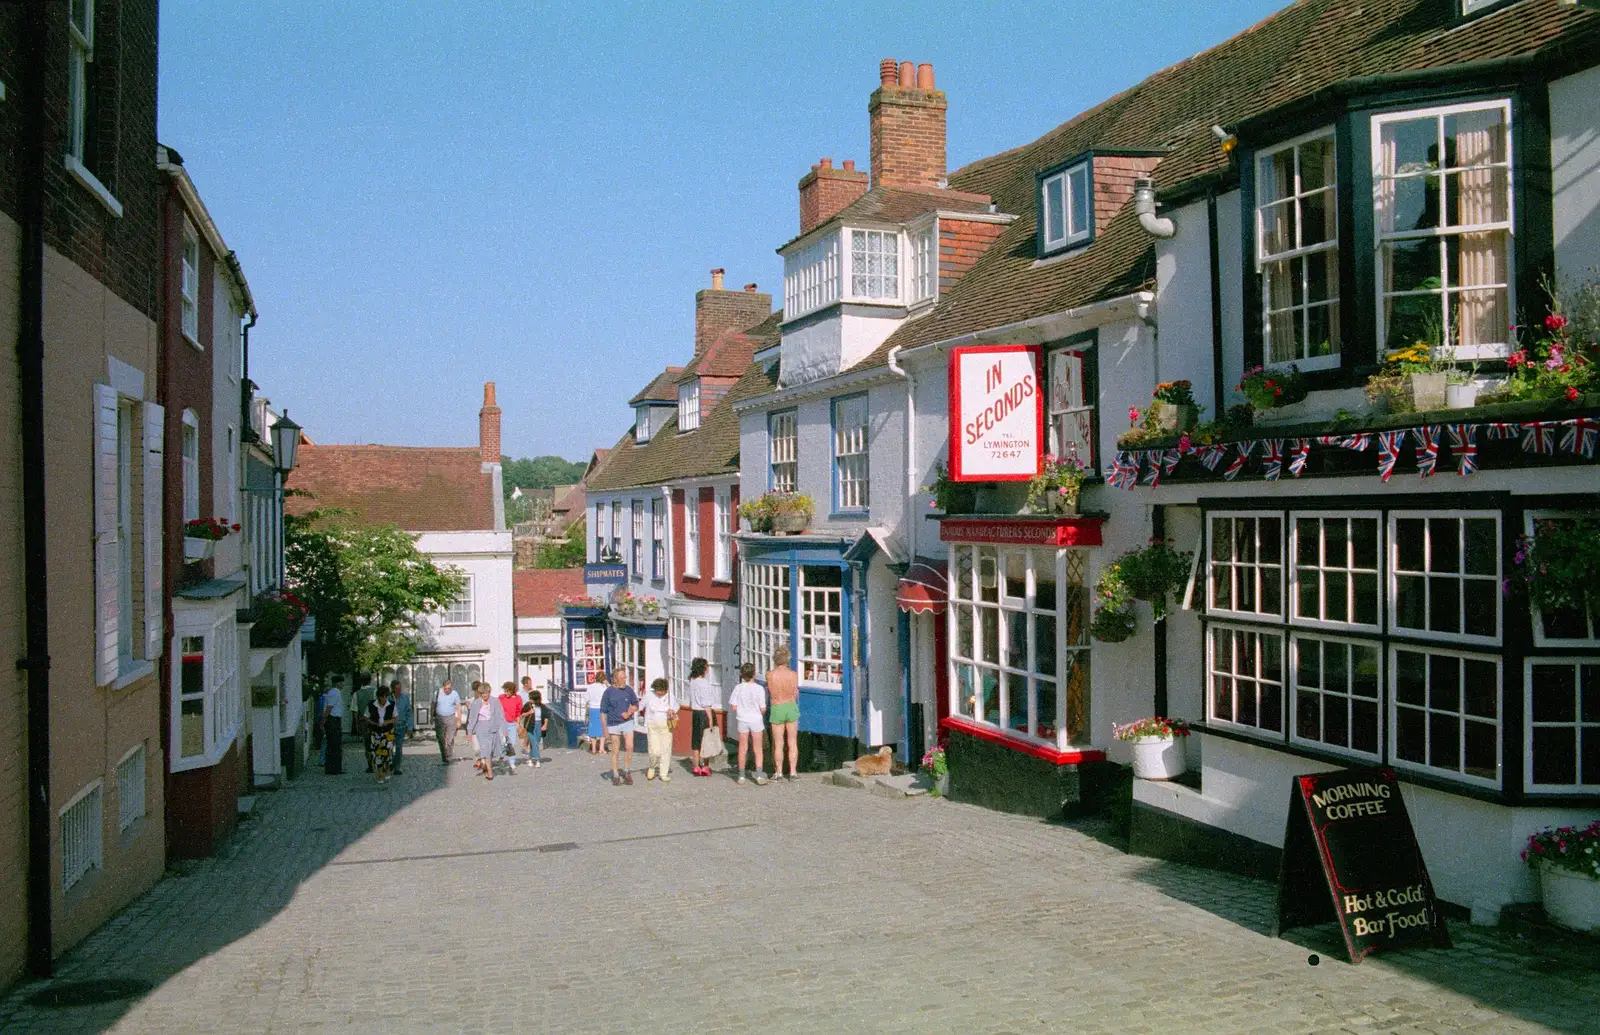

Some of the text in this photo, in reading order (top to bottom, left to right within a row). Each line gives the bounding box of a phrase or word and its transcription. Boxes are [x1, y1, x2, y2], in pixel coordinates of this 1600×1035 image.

[986, 360, 1002, 394] IN
[966, 375, 1033, 445] SECONDS
[984, 440, 1030, 449] LYMINGTON
[991, 450, 1022, 459] 72647
[1024, 528, 1056, 539] SECONDS
[587, 569, 624, 577] SHIPMATES
[1312, 783, 1391, 808] MORNING
[1326, 800, 1387, 820] COFFEE
[1344, 884, 1425, 914] Hot & Cold
[1353, 908, 1429, 938] Bar Food
